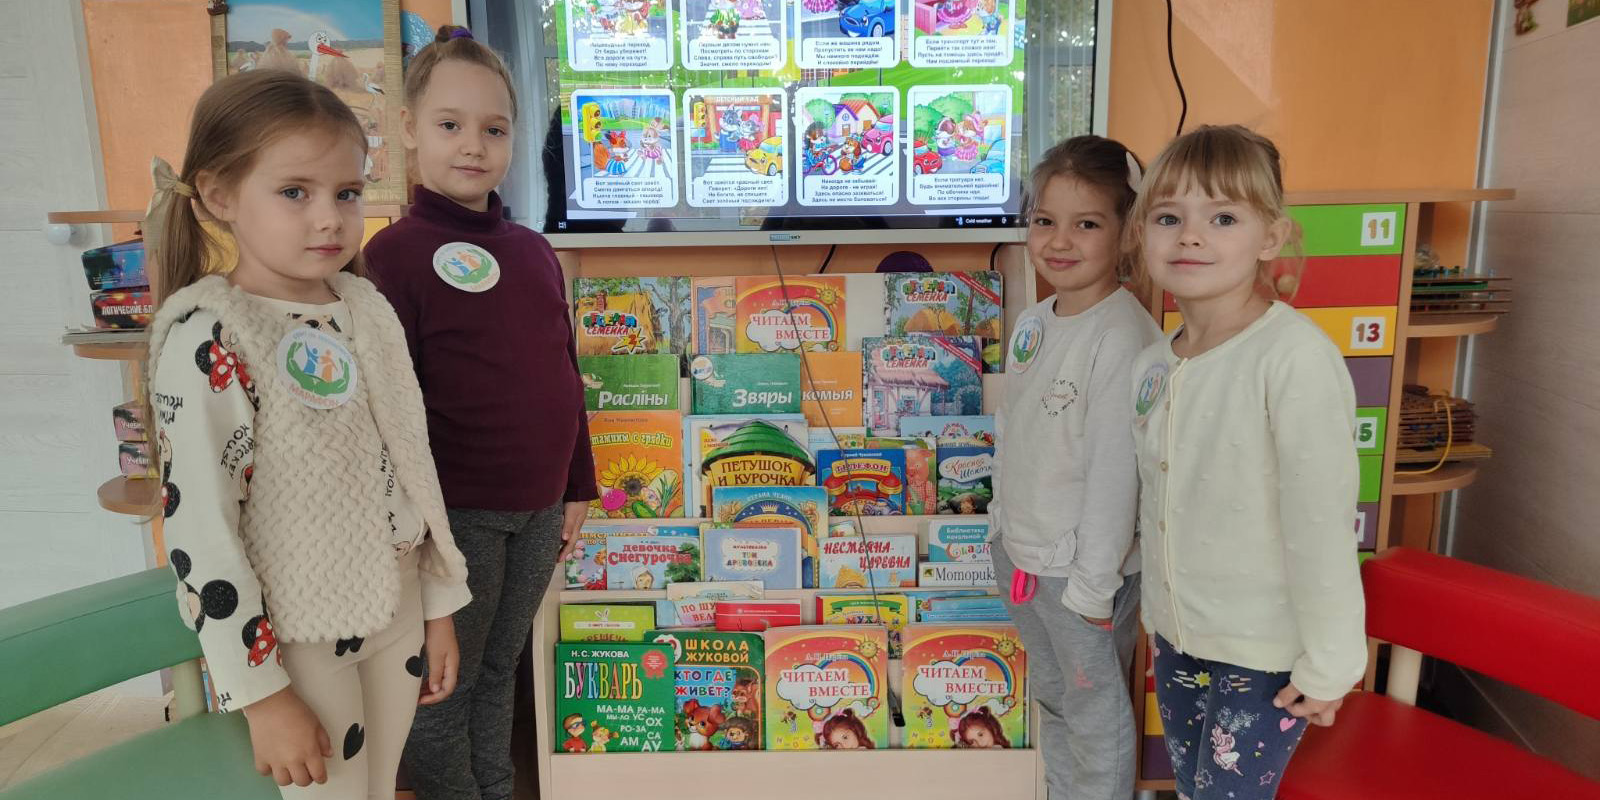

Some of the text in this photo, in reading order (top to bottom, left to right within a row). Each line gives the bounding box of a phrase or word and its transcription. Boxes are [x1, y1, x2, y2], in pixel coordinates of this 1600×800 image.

[1367, 218, 1390, 239] 11
[102, 304, 153, 316] ЛОГИЧЕСКИЕ БЛ
[752, 316, 808, 326] ЧИТАЕМ
[586, 323, 628, 335] СЕМЕЙКА
[776, 329, 829, 340] ВМЕСТЕ
[1356, 323, 1380, 342] 13
[628, 334, 638, 346] 2
[598, 390, 668, 408] Расліны
[732, 388, 792, 408] Звяры
[721, 459, 794, 474] ПЕТУШОК
[835, 463, 890, 474] ТЕЛЕФОН
[960, 464, 992, 480] Шапочк
[718, 473, 796, 486] И КУРОЧКА
[622, 544, 678, 553] девочка
[946, 543, 992, 560] Сказк
[608, 552, 693, 566] Снегурочка
[860, 556, 910, 572] ЦАРЕВНА
[686, 640, 749, 650] ШКОЛА
[572, 650, 630, 658] Н. С. ЖУКОВА
[686, 650, 749, 663] ЖУКОВОЙ
[674, 671, 732, 682] КТО ГДЕ
[782, 670, 846, 682] ЧИТАЕМ
[920, 668, 982, 678] ЧИТАЕМ
[564, 662, 643, 700] БУКВАРЬ
[675, 687, 730, 696] ЖИВЕТ?
[809, 685, 870, 696] ВМЕСТЕ
[946, 682, 1006, 694] ВМЕСТЕ
[597, 705, 634, 714] МА-МА
[646, 717, 662, 727] ОХ
[647, 732, 661, 740] СА
[620, 736, 661, 752] АМ АУ
